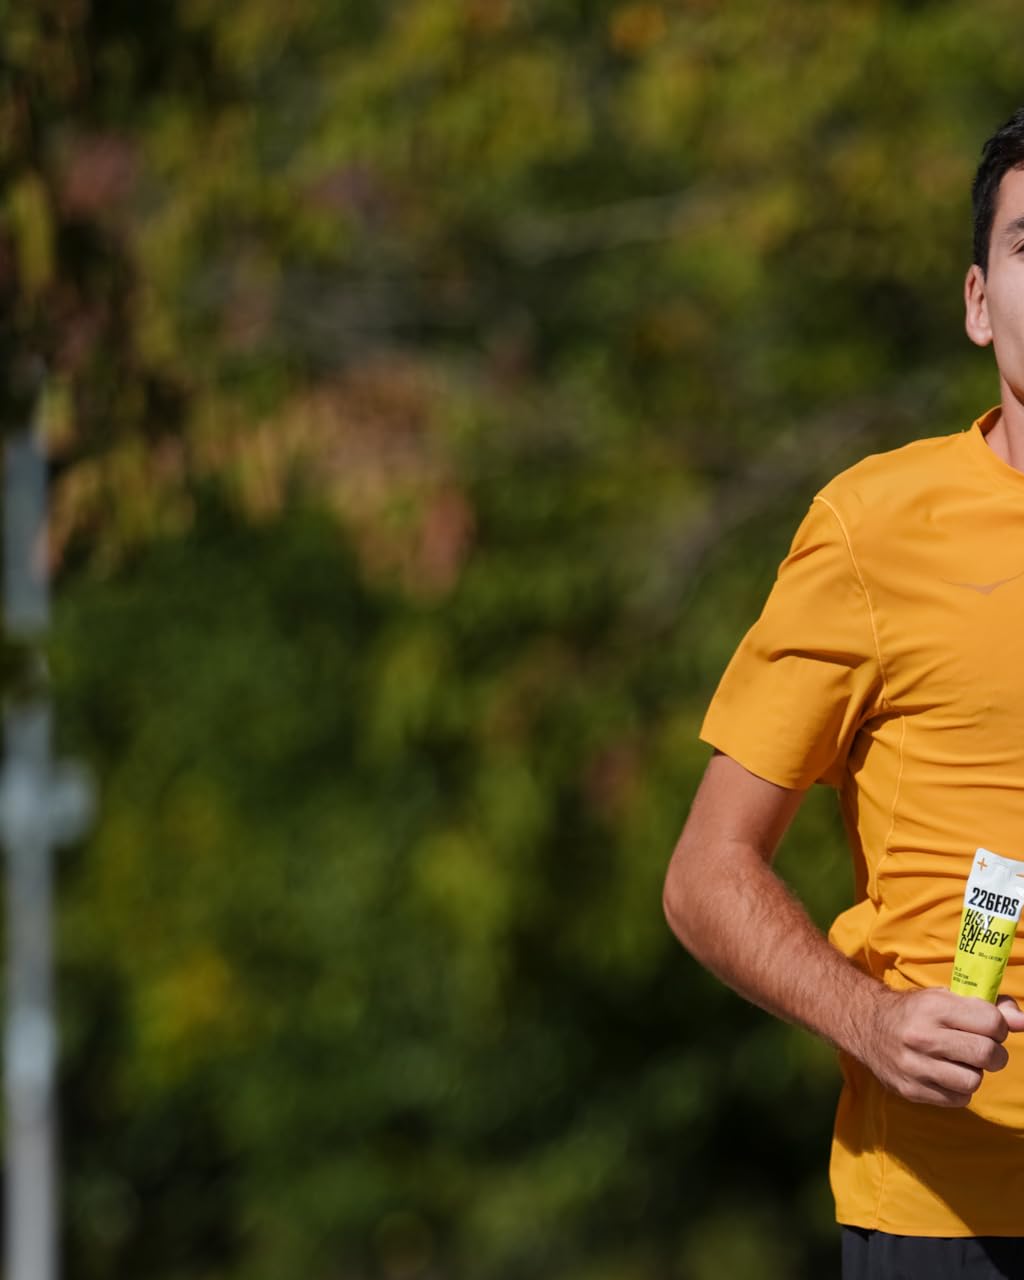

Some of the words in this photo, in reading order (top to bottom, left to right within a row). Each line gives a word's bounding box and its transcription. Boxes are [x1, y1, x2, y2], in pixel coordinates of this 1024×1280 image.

[968, 887, 1020, 917] 226ERS
[959, 936, 977, 955] GEL
[961, 922, 1010, 948] ENERGY
